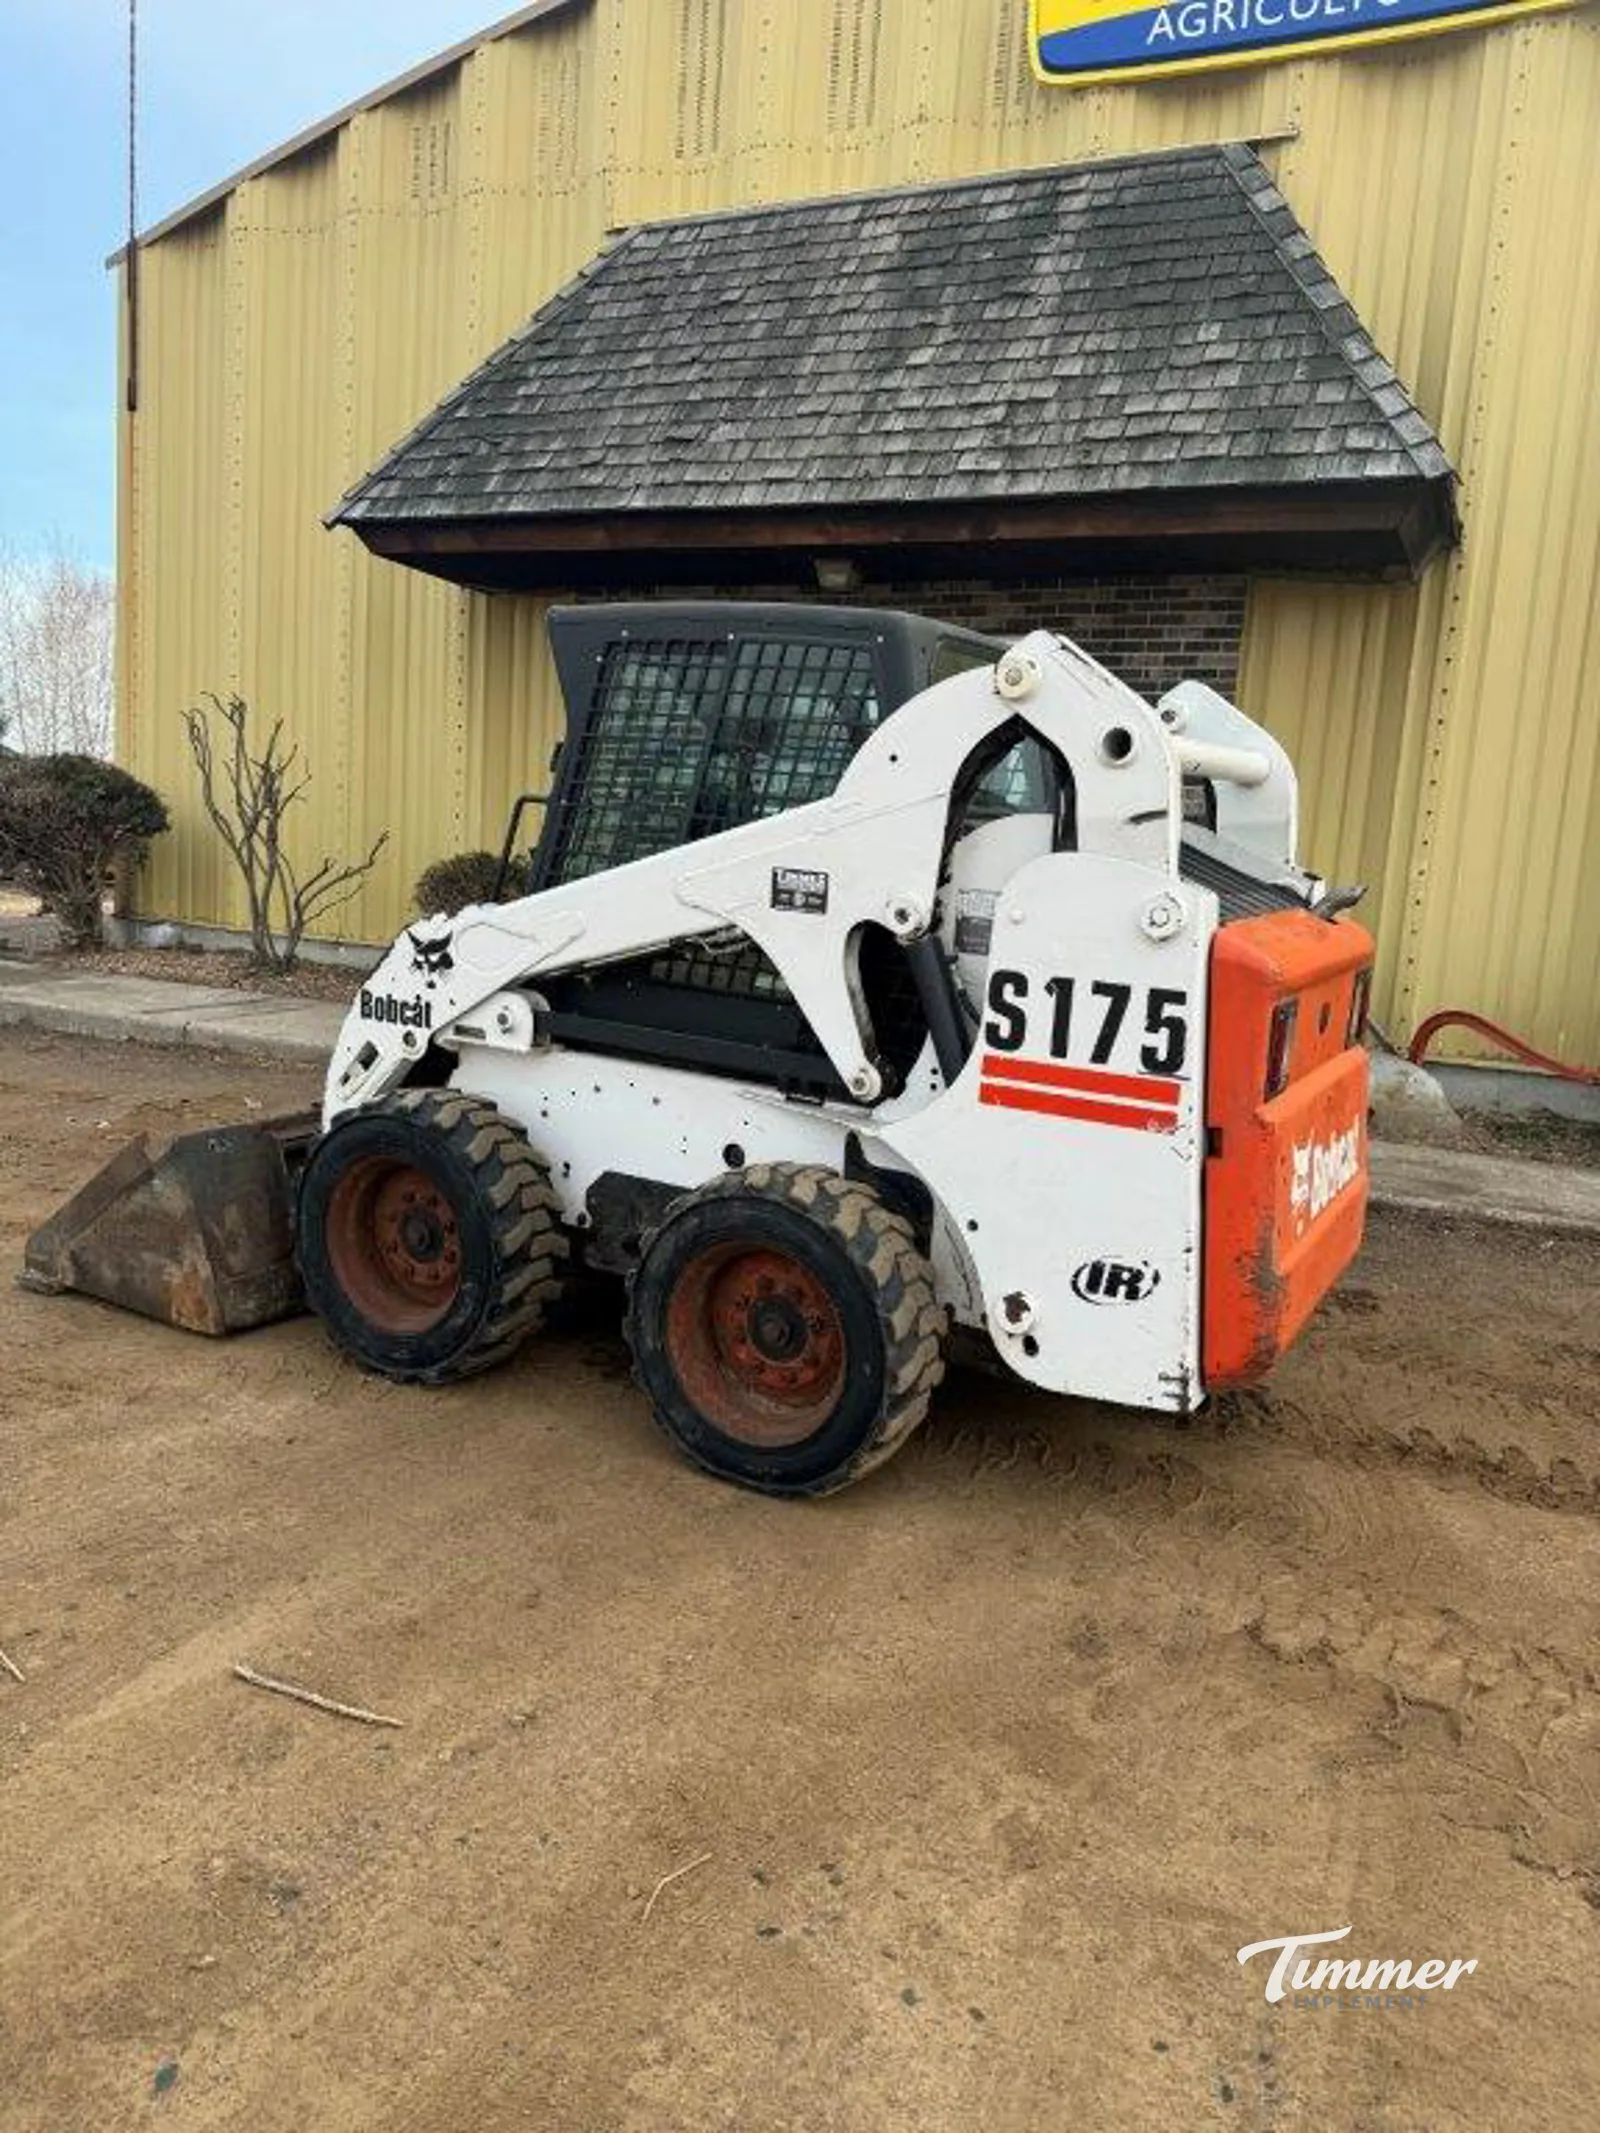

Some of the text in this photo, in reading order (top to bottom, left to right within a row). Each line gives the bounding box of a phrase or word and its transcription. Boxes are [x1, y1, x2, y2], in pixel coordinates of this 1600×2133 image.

[1146, 0, 1400, 45] AGRICU
[360, 989, 432, 1029] Bobcat
[984, 968, 1188, 1074] S175
[1084, 1259, 1146, 1301] IR
